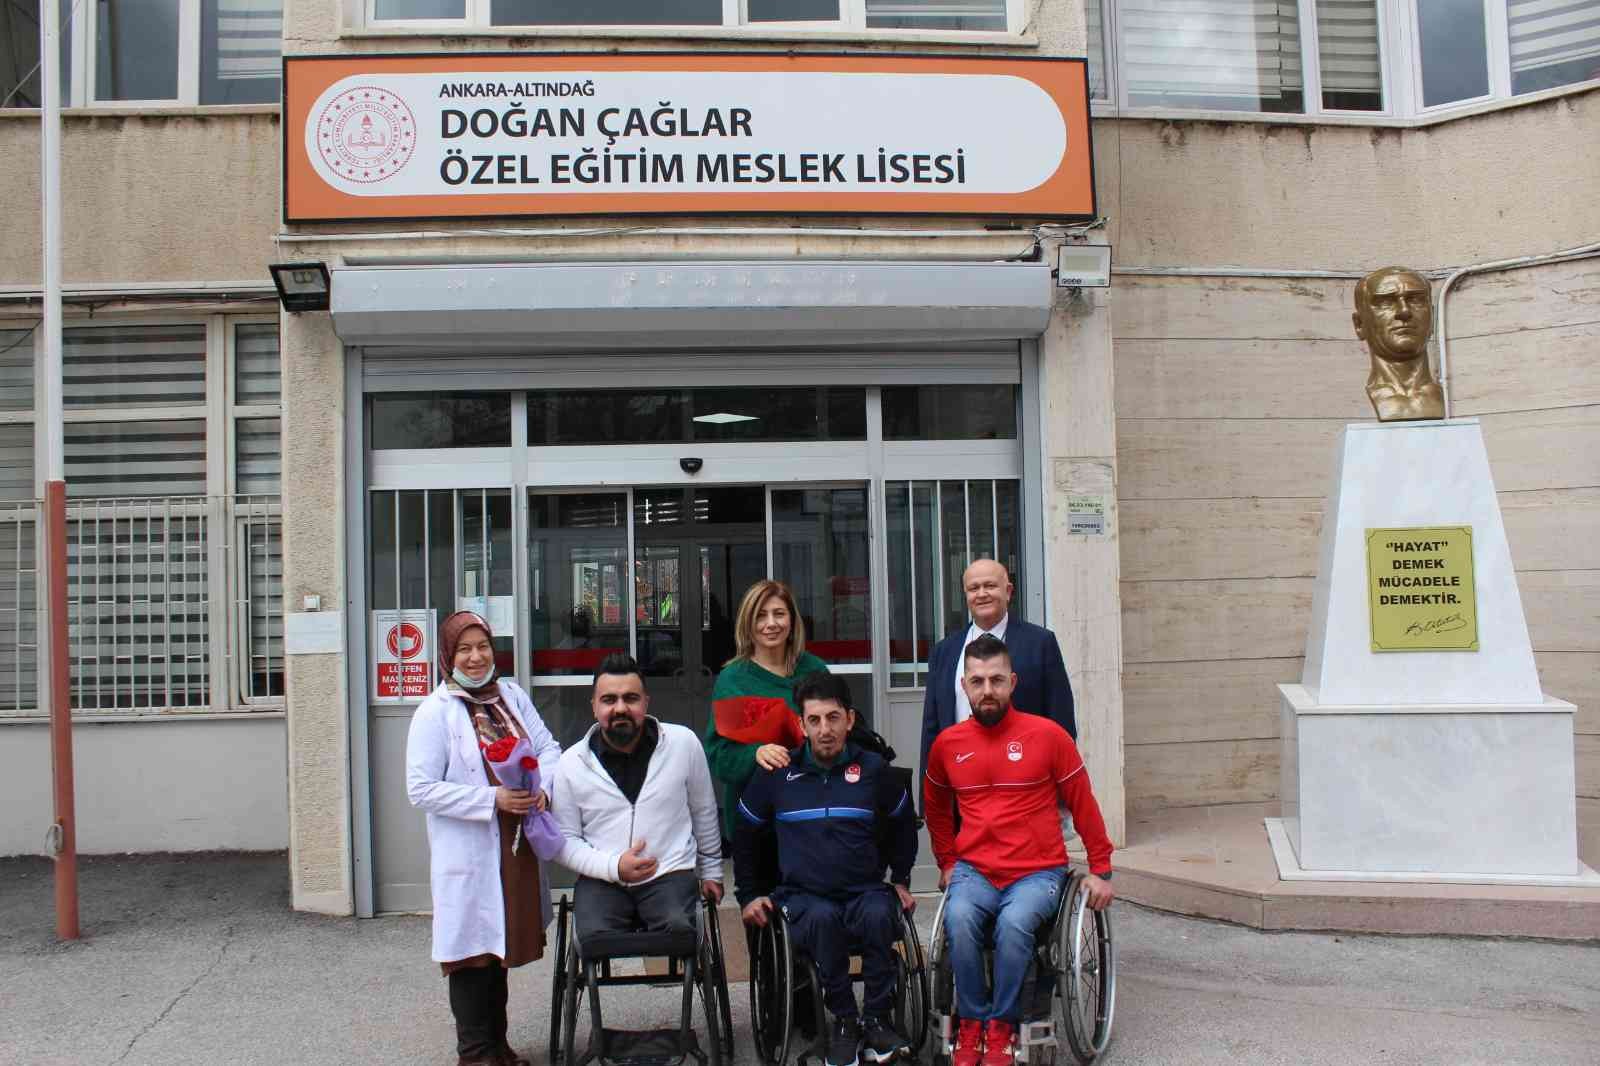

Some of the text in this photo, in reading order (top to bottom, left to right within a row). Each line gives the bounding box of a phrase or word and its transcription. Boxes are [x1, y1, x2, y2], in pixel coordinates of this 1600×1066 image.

[440, 80, 594, 98] ANKARA-ALTINDAĞ
[442, 102, 752, 146] DOĞAN ÇAĞLAR
[441, 147, 965, 185] ÖZEL EĞİTİM MESLEK LİSESİ
[1392, 559, 1445, 570] DEMEK
[1379, 576, 1461, 588] MÜCADELE
[1380, 592, 1461, 606] DEMEKTİR.
